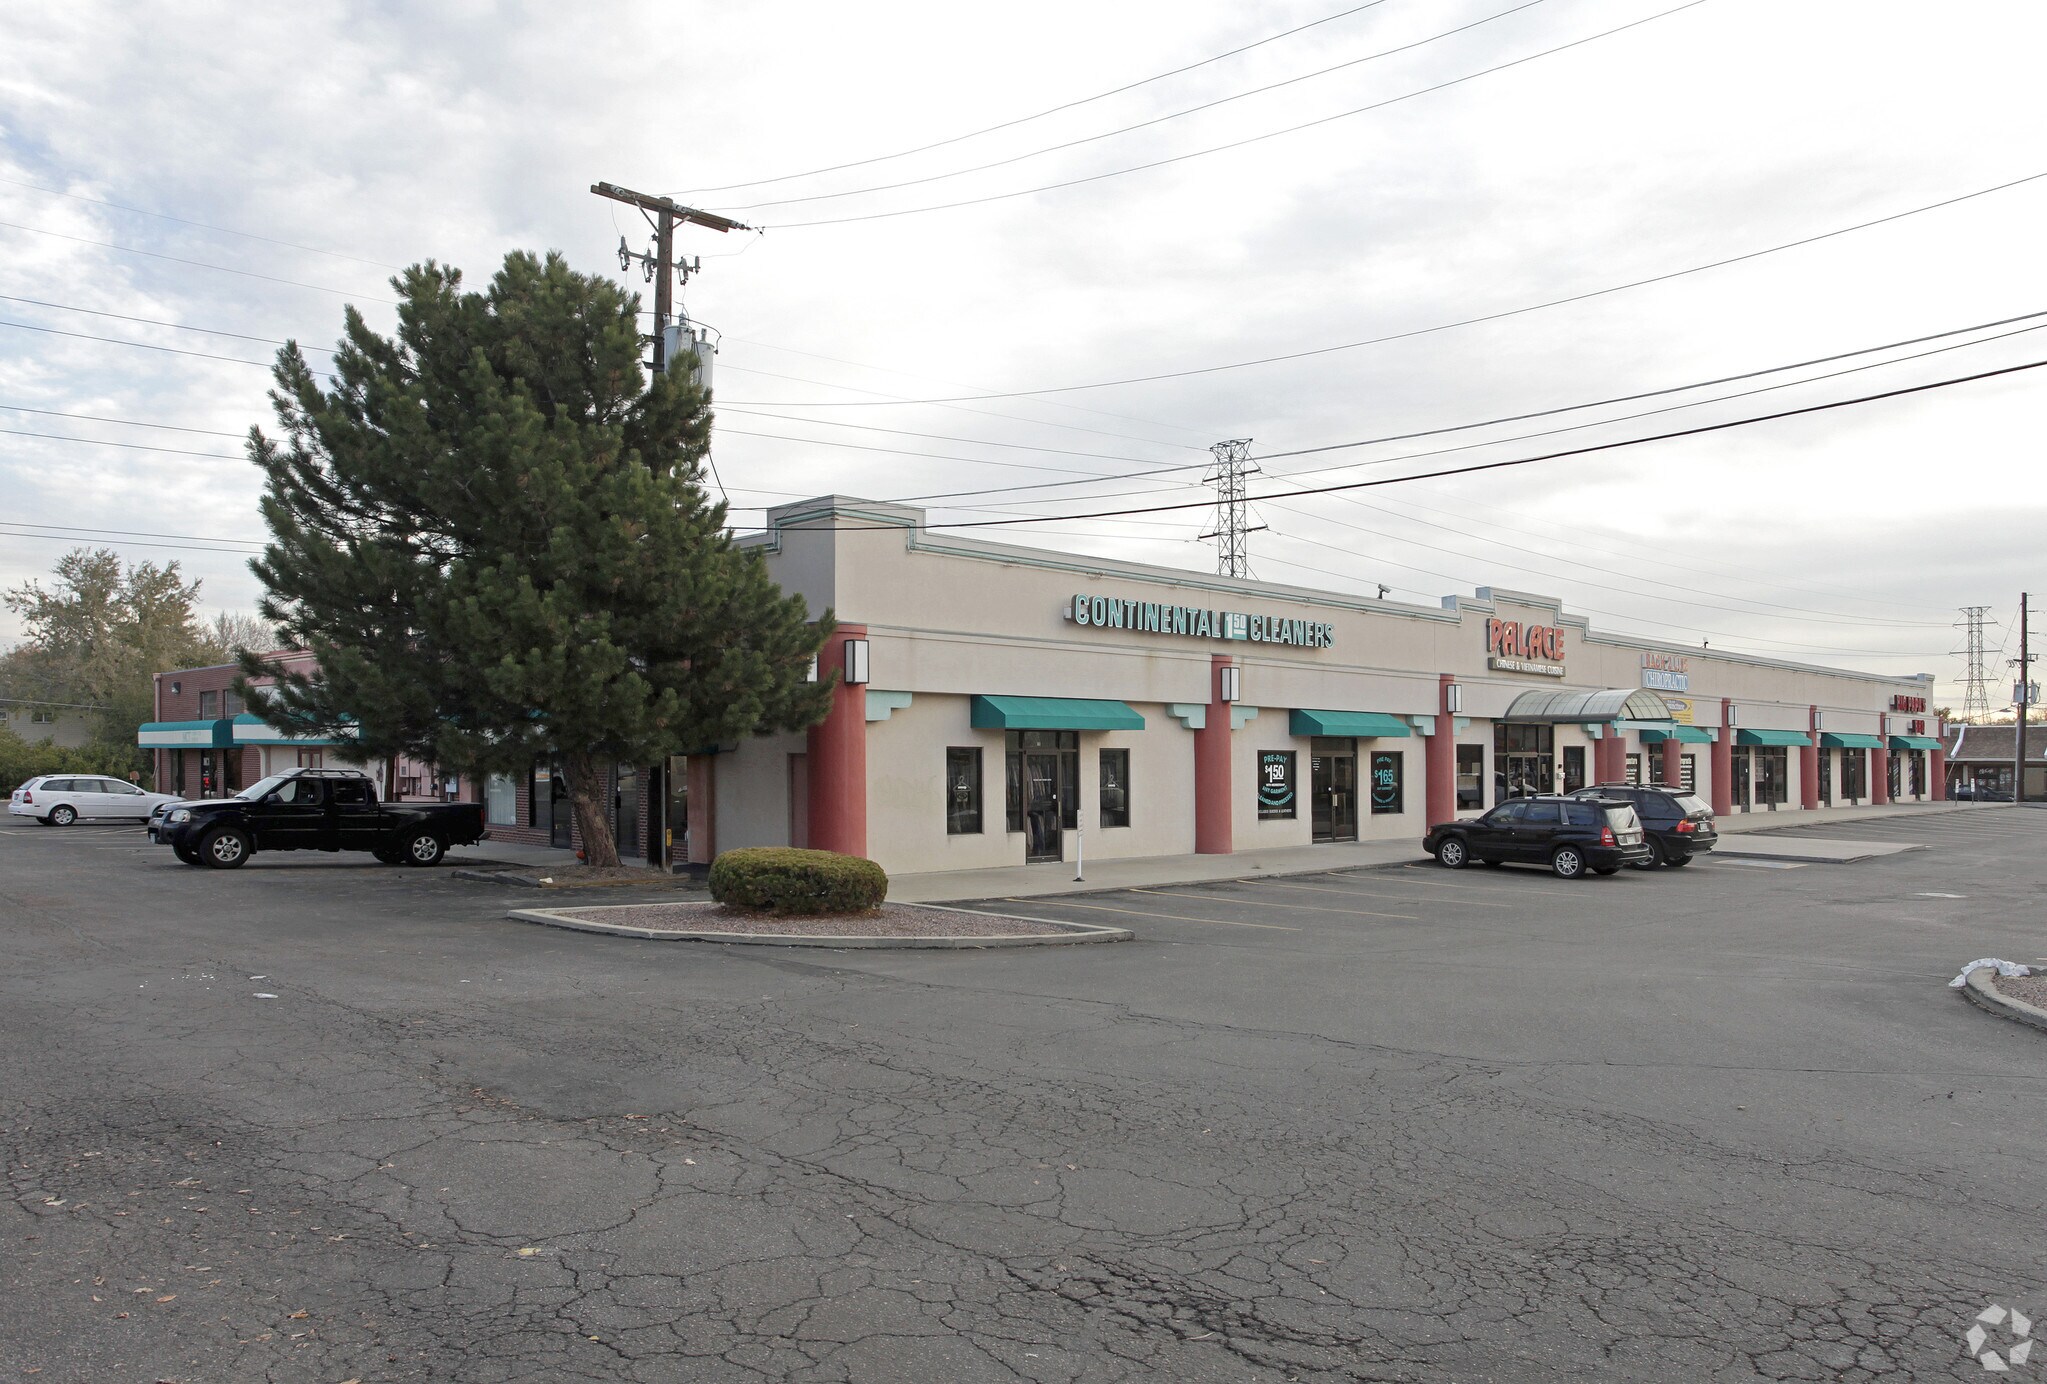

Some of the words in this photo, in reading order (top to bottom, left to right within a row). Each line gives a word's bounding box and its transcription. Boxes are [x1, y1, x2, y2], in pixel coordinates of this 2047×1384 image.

[1073, 593, 1221, 638] CONTINENTAL
[1250, 614, 1334, 648] CLEANERS
[1488, 618, 1565, 660] PALACE
[1496, 659, 1515, 670] CHINESE
[1646, 671, 1688, 690] CHIROPRACTIC
[1263, 755, 1287, 764] PRE-PAY
